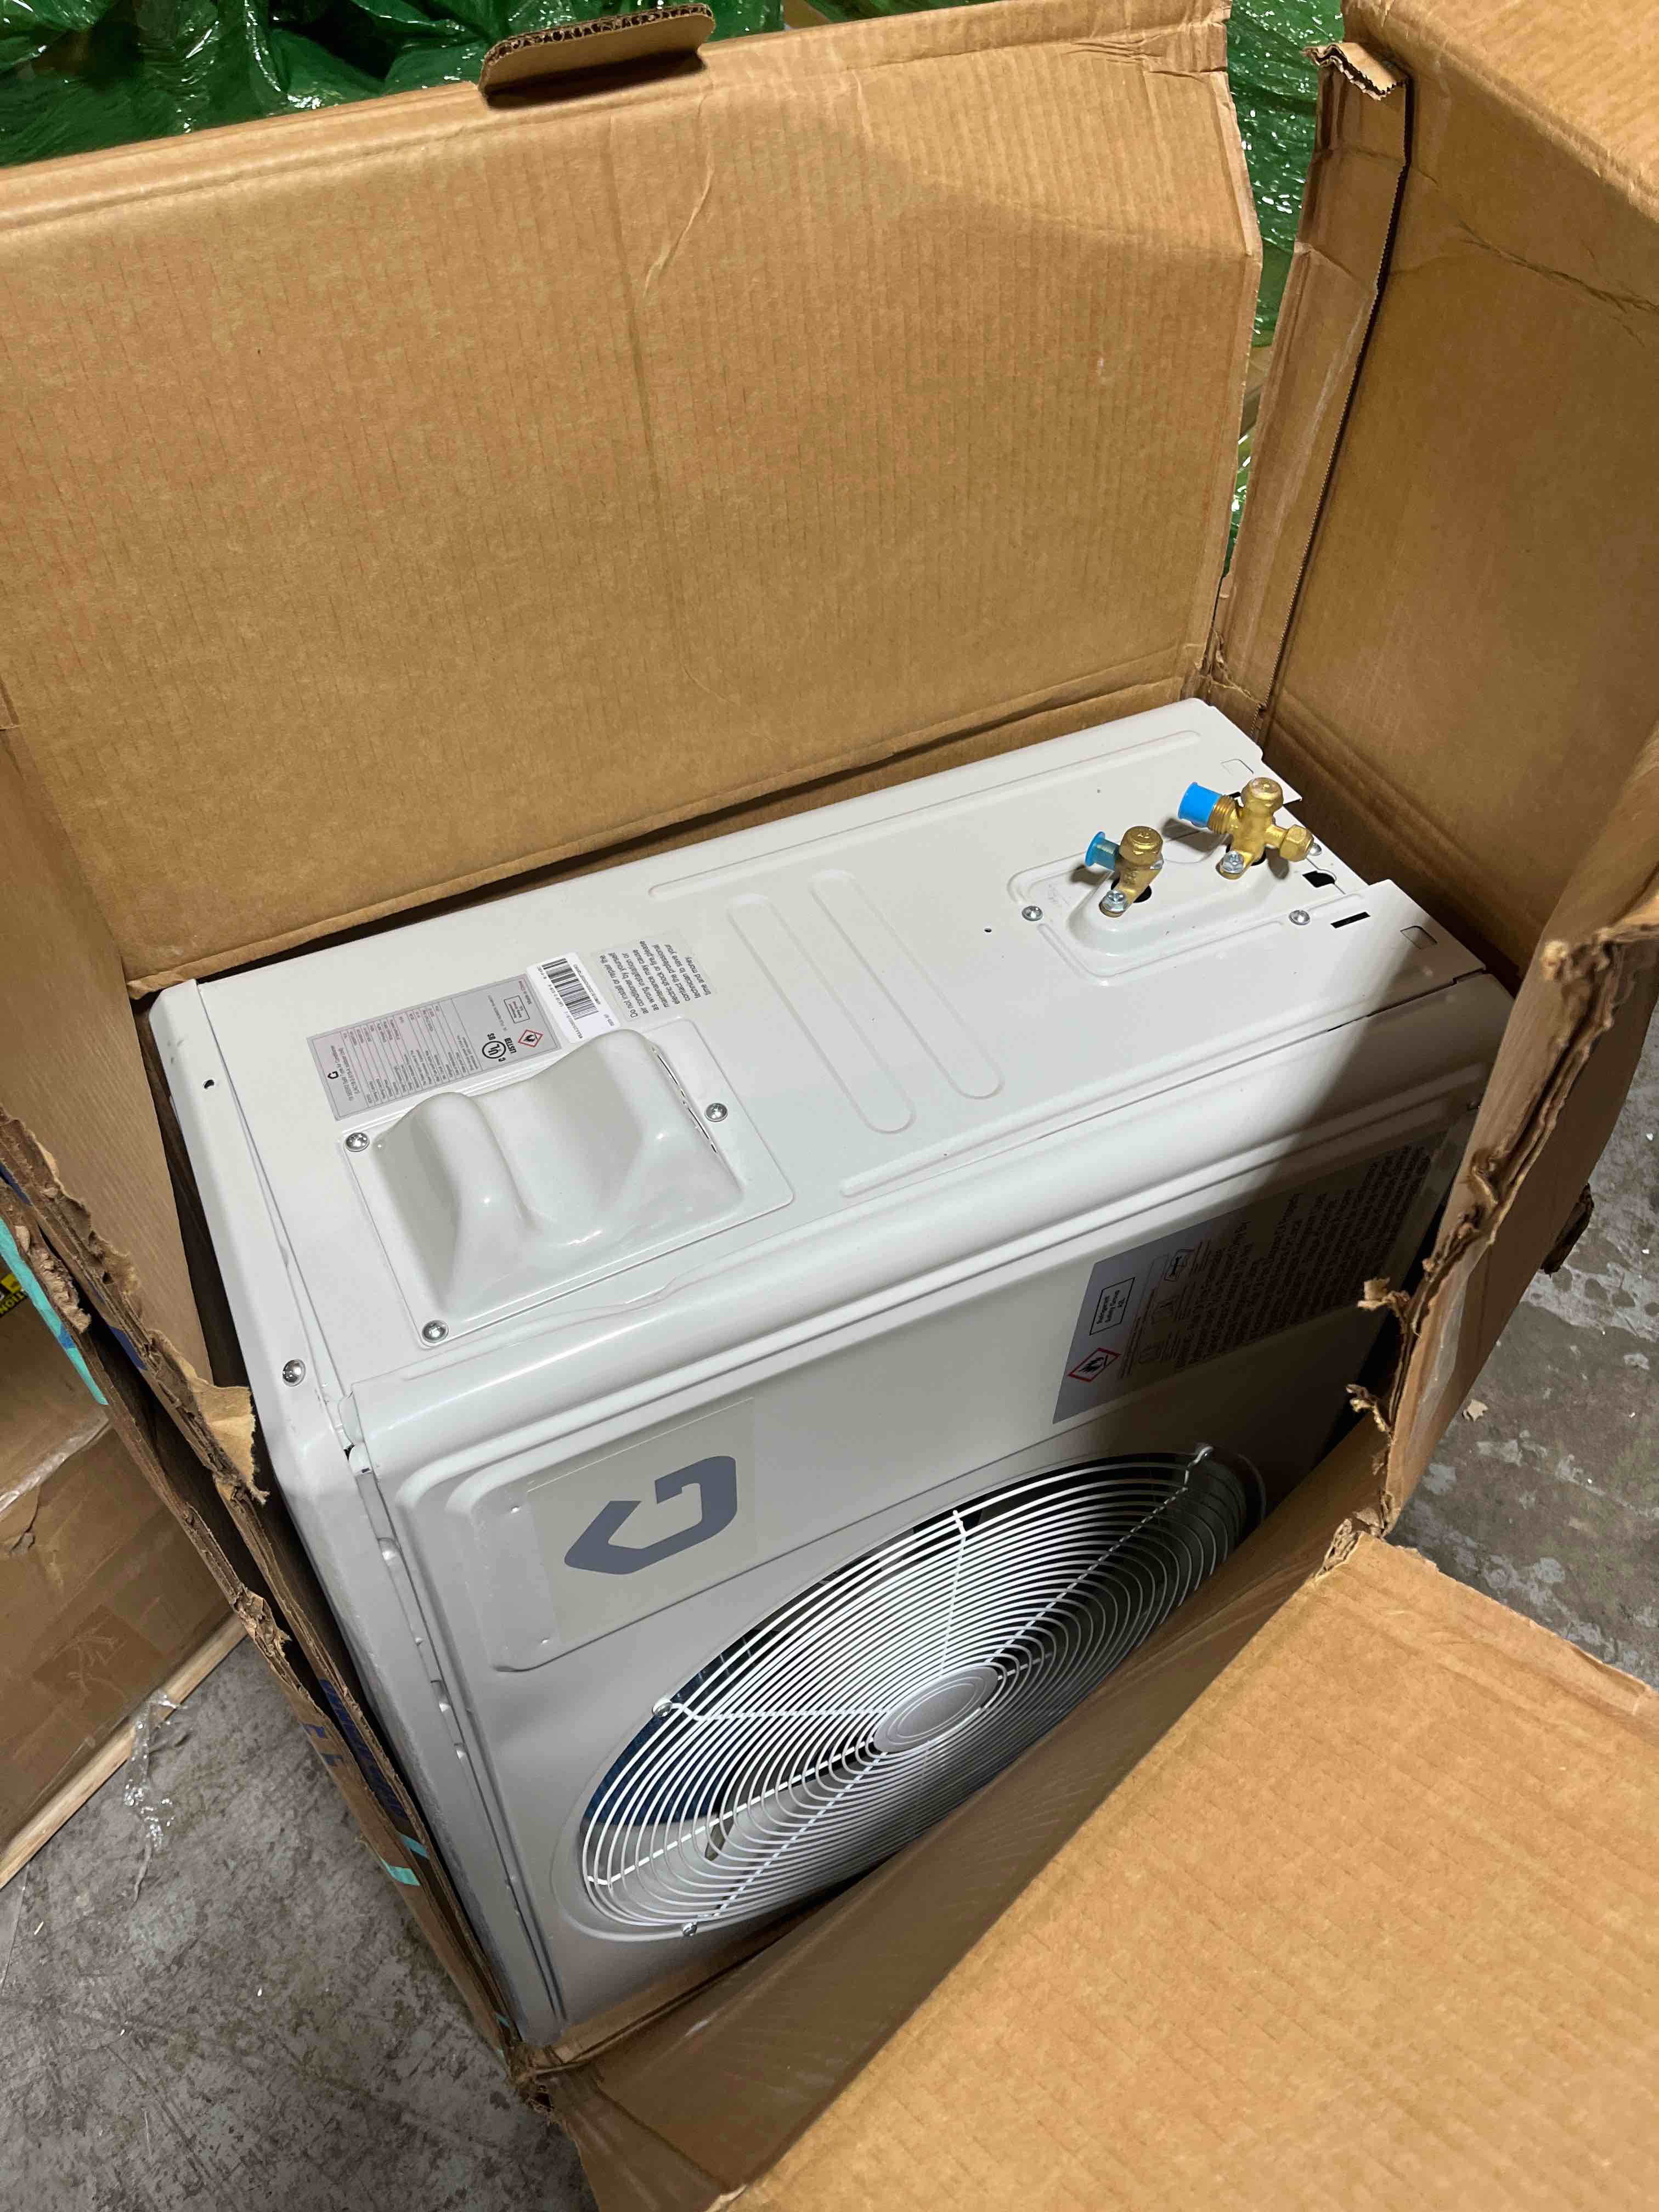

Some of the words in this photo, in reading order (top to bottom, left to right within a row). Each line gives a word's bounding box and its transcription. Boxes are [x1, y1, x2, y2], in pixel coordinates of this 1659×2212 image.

[633, 950, 645, 964] cause
[652, 944, 675, 973] professional
[672, 956, 682, 967] save
[626, 959, 645, 986] installation
[641, 965, 651, 975] may
[685, 957, 698, 973] money
[657, 972, 670, 986] shock
[671, 974, 679, 982] the
[682, 973, 701, 998] technician
[695, 974, 704, 983] and
[614, 985, 628, 1000] install
[625, 980, 644, 1006] conditioner
[642, 986, 654, 1003] wrong
[648, 976, 669, 1007] maintenance
[666, 986, 680, 1004] electric
[675, 983, 690, 1001] contact
[701, 984, 711, 995] time
[624, 1000, 633, 1008] not
[630, 1009, 638, 1018] Do
[504, 1037, 517, 1053] LISTED
